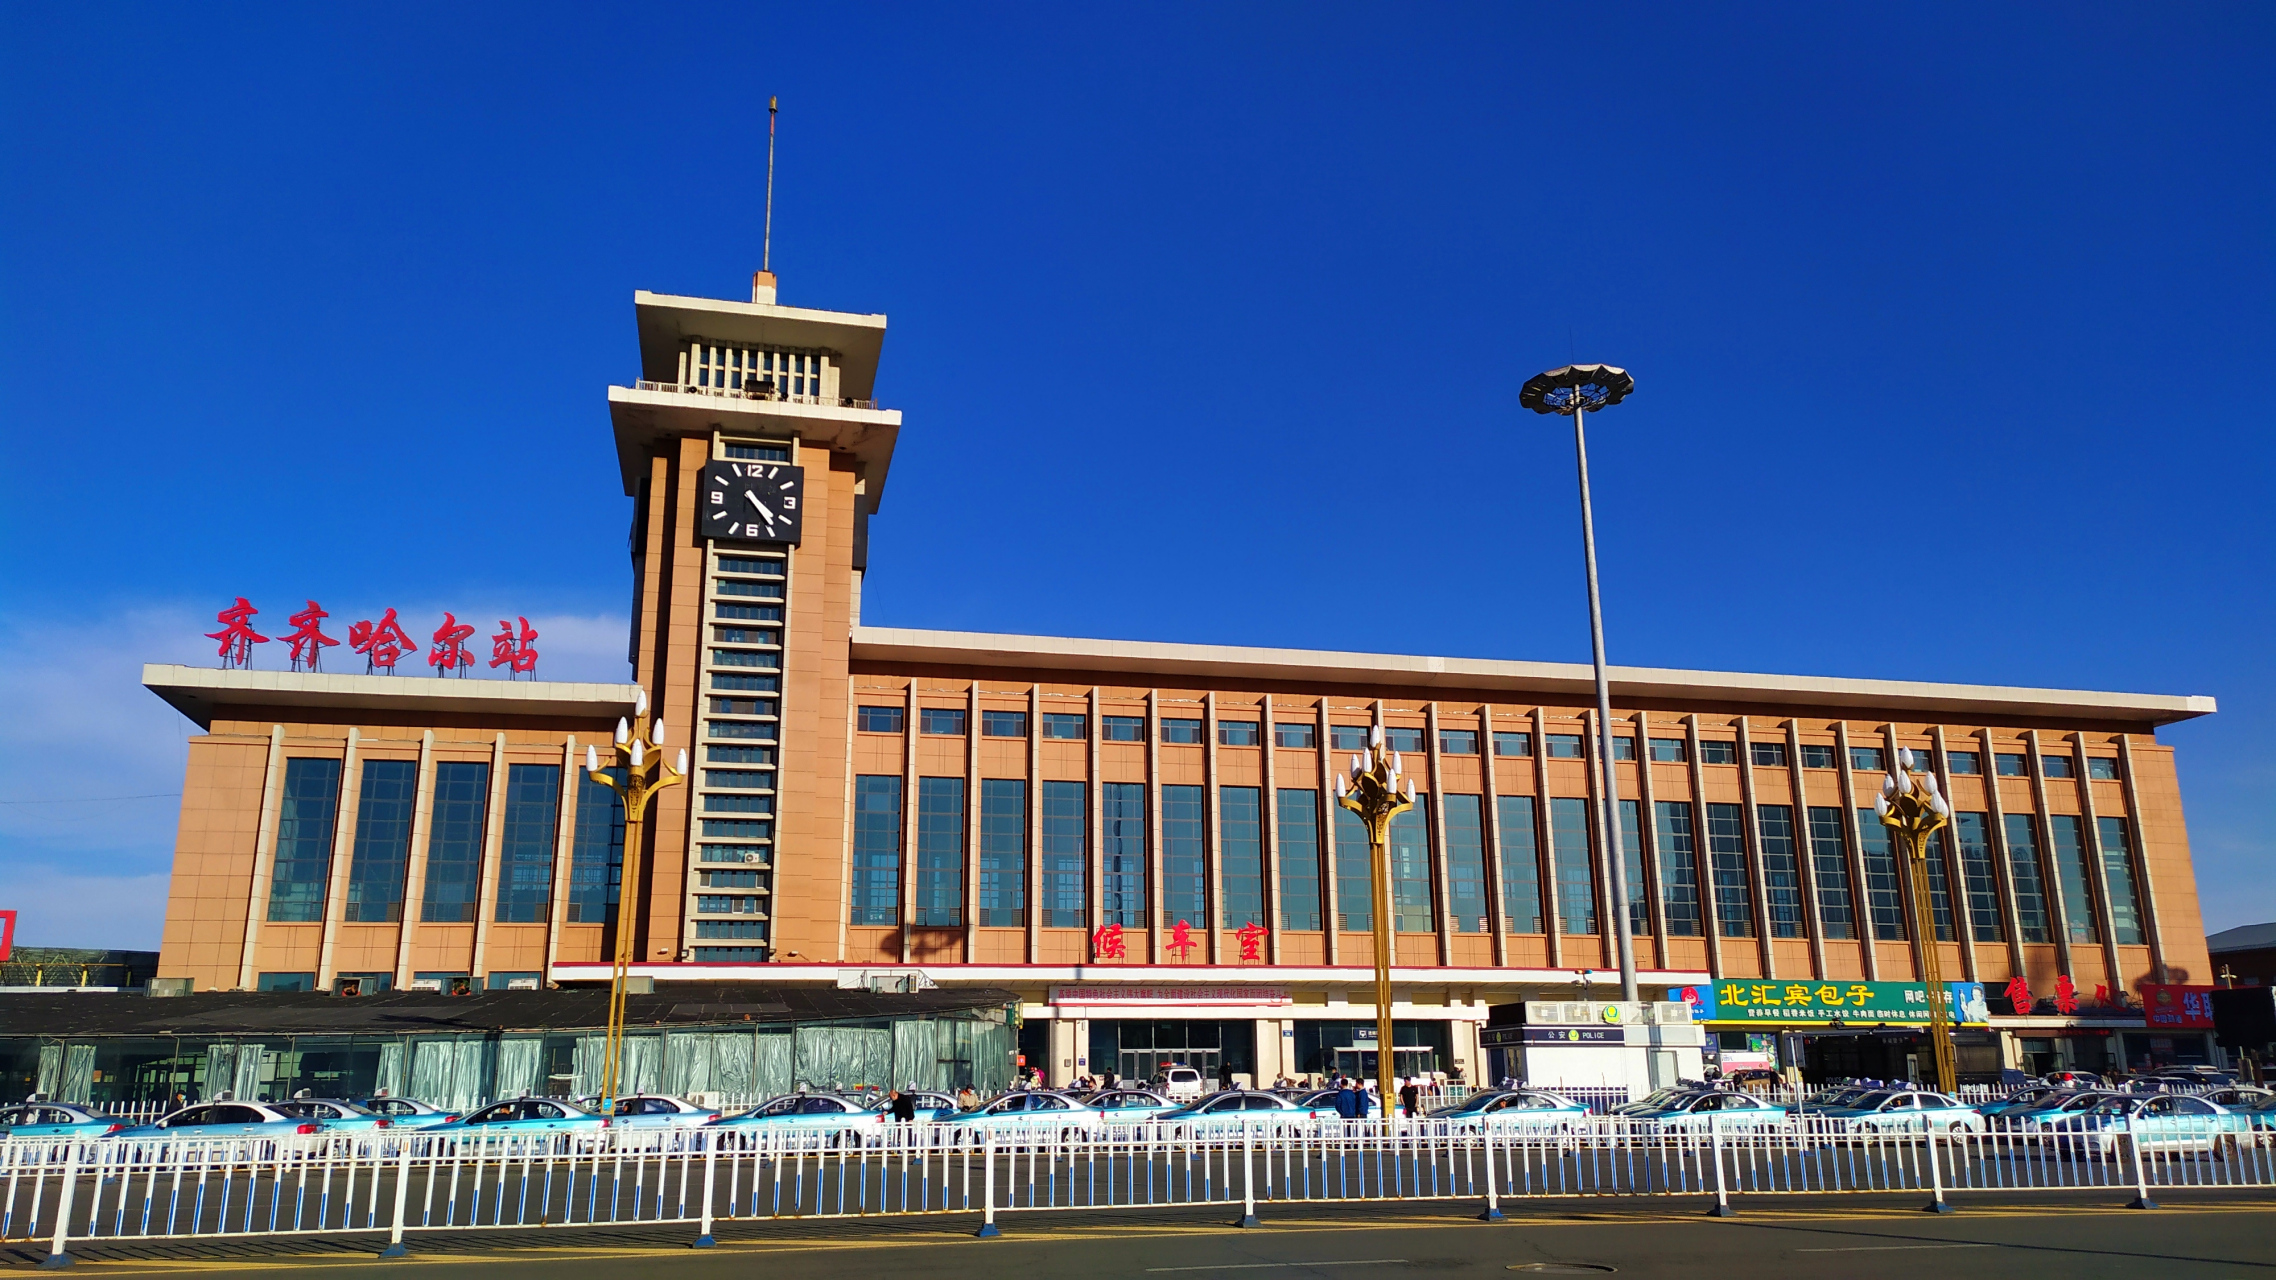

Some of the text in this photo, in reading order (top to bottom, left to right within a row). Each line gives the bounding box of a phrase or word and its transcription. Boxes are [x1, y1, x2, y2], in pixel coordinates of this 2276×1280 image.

[746, 464, 764, 478] 12
[711, 491, 797, 510] 9 3
[745, 523, 760, 537] 6
[204, 595, 540, 674] 齐齐哈尔站
[1091, 918, 1270, 961] 候车室
[1718, 983, 1876, 1007] 北汇宾包子
[2003, 974, 2128, 1015] 售票处
[1547, 1030, 1567, 1039] 公安
[1582, 1030, 1605, 1039] POLICE
[1825, 1076, 1842, 1084] POLICE
